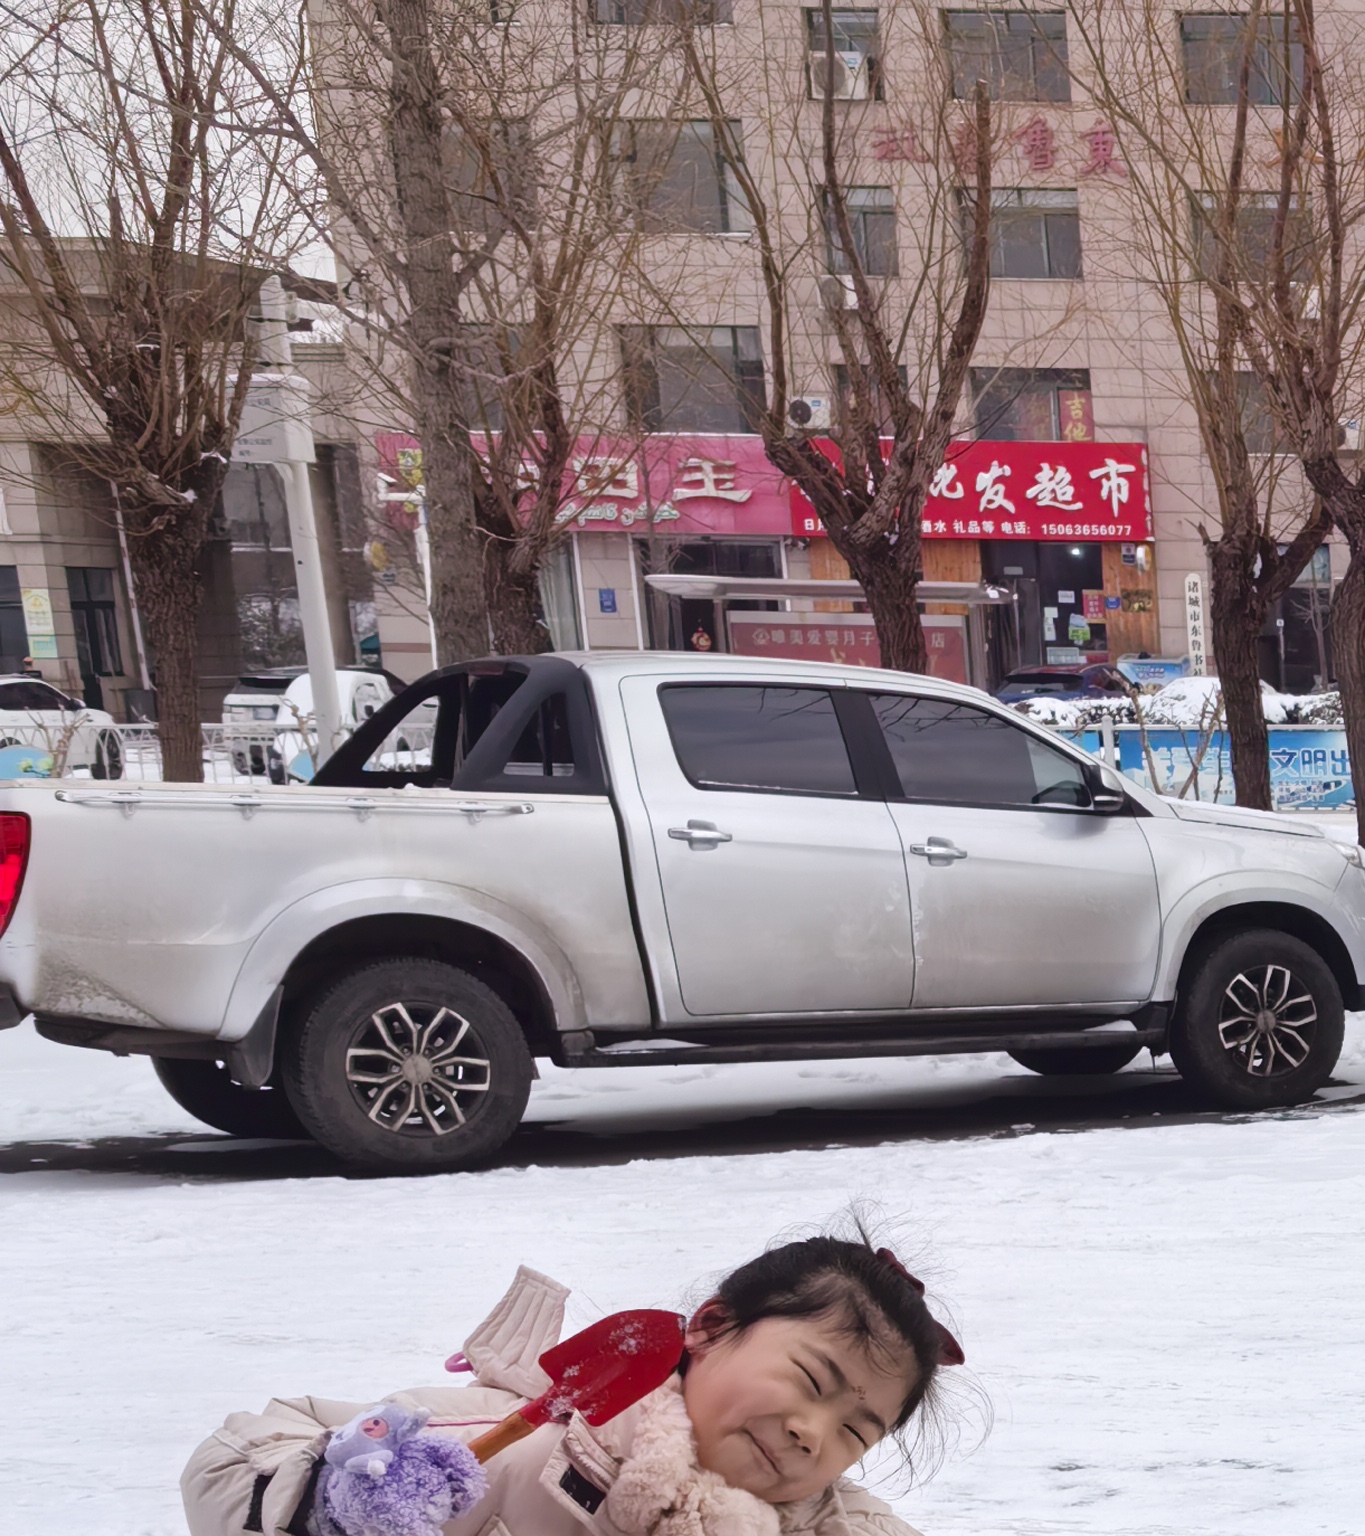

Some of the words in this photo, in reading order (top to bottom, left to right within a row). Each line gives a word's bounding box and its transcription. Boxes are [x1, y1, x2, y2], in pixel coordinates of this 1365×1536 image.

[953, 519, 994, 534] 礼品等
[1042, 523, 1133, 537] 15063656077
